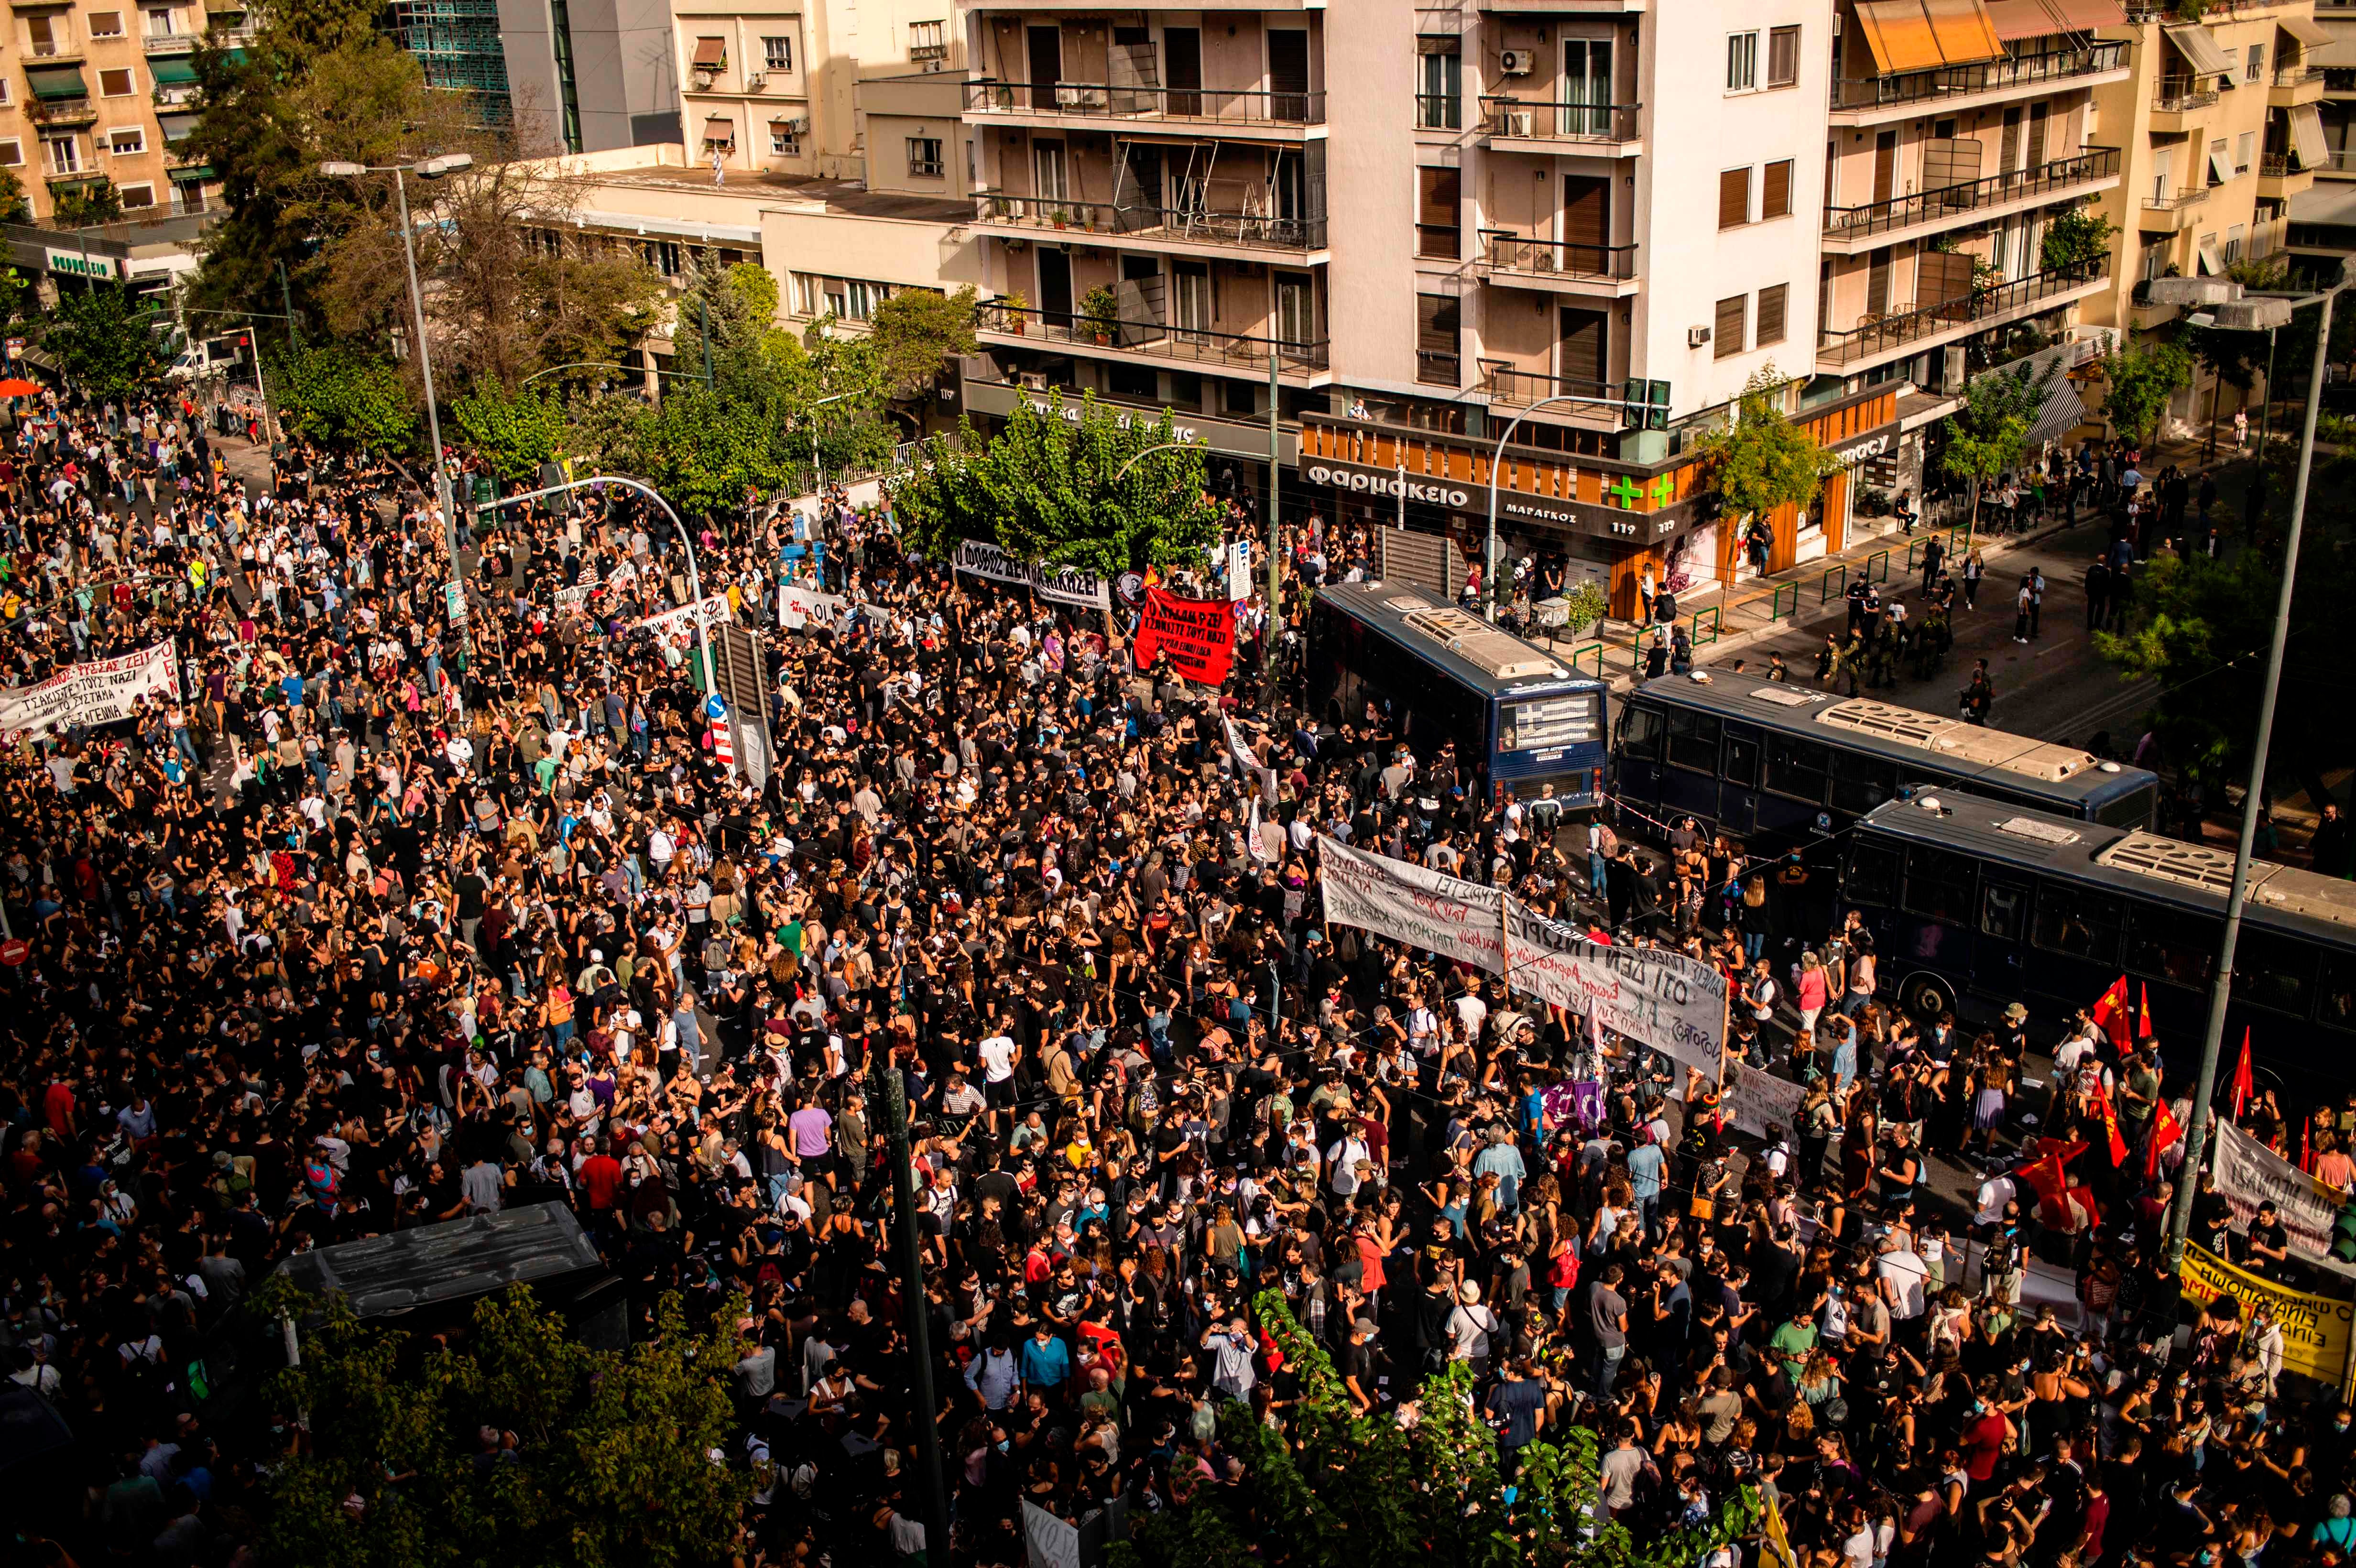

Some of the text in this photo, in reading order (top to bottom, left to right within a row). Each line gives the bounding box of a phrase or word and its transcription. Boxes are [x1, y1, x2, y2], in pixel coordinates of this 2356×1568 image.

[53, 255, 107, 277] φαρμαειο
[1505, 502, 1577, 524] ΜΑΡΑΓΚΟΣ
[1612, 522, 1636, 536] 119
[1658, 519, 1675, 533] 119
[965, 544, 1003, 576] ΦΟΒΟΣ
[690, 600, 721, 619] ΝΖΙ
[814, 603, 827, 621] ΟΙ
[1206, 631, 1227, 644] ΝΑΖΙ
[77, 660, 120, 676] ΦΥΣΣΑΣ
[22, 670, 137, 712] ΤΣΑΚΙΣΤΕ ΤΟΥΣ ΝΑΖΙ
[58, 700, 70, 712] ΤΟ
[73, 688, 115, 707] ΣΥΣΤΗΜΑ
[89, 704, 122, 723] ΓΕΝΝΑ
